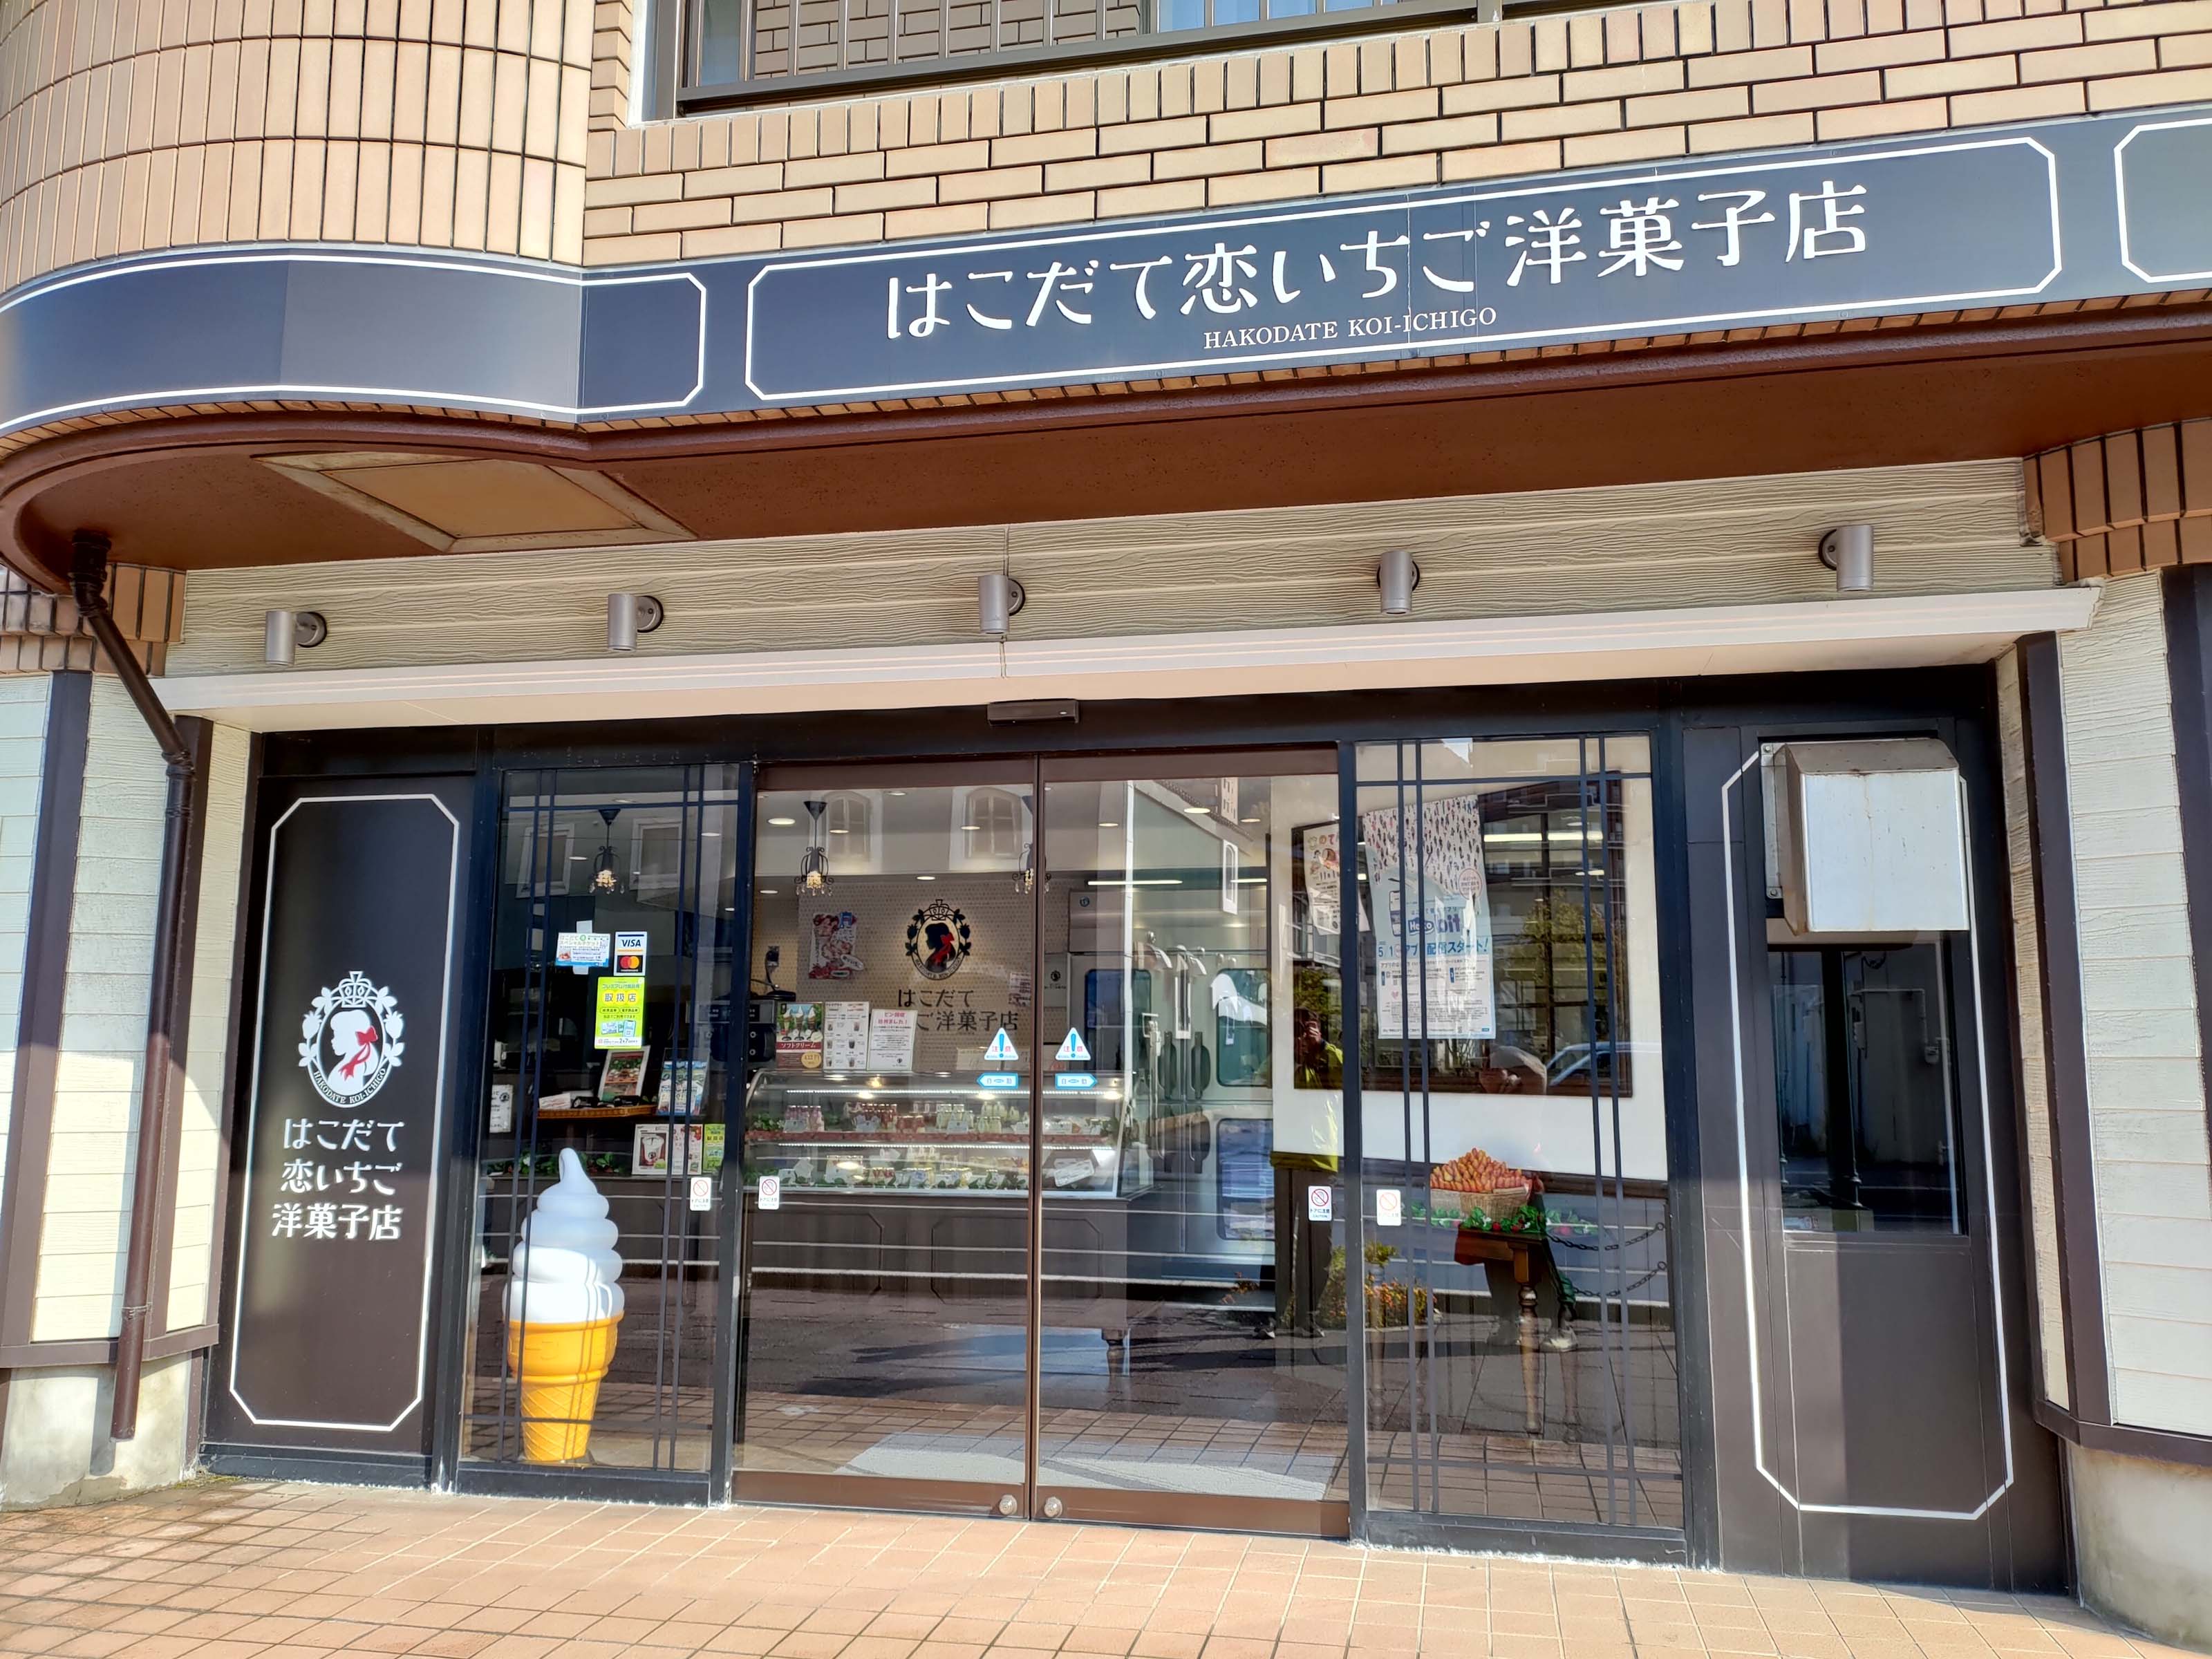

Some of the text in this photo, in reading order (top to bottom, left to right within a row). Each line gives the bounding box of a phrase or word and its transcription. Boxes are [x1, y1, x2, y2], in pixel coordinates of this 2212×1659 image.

[886, 184, 1868, 339] はこだて恋いちご洋菓子店
[1203, 307, 1497, 349] HAKODATE KOI-ICHIGO
[604, 993, 637, 1003] 取扱店
[899, 989, 974, 1008] はこだて
[313, 1068, 386, 1104] HAKODATE KOI-ICHIGO
[283, 1118, 405, 1152] はこだて
[281, 1159, 403, 1196] 恋いちご
[271, 1203, 404, 1241] 洋菓子店
